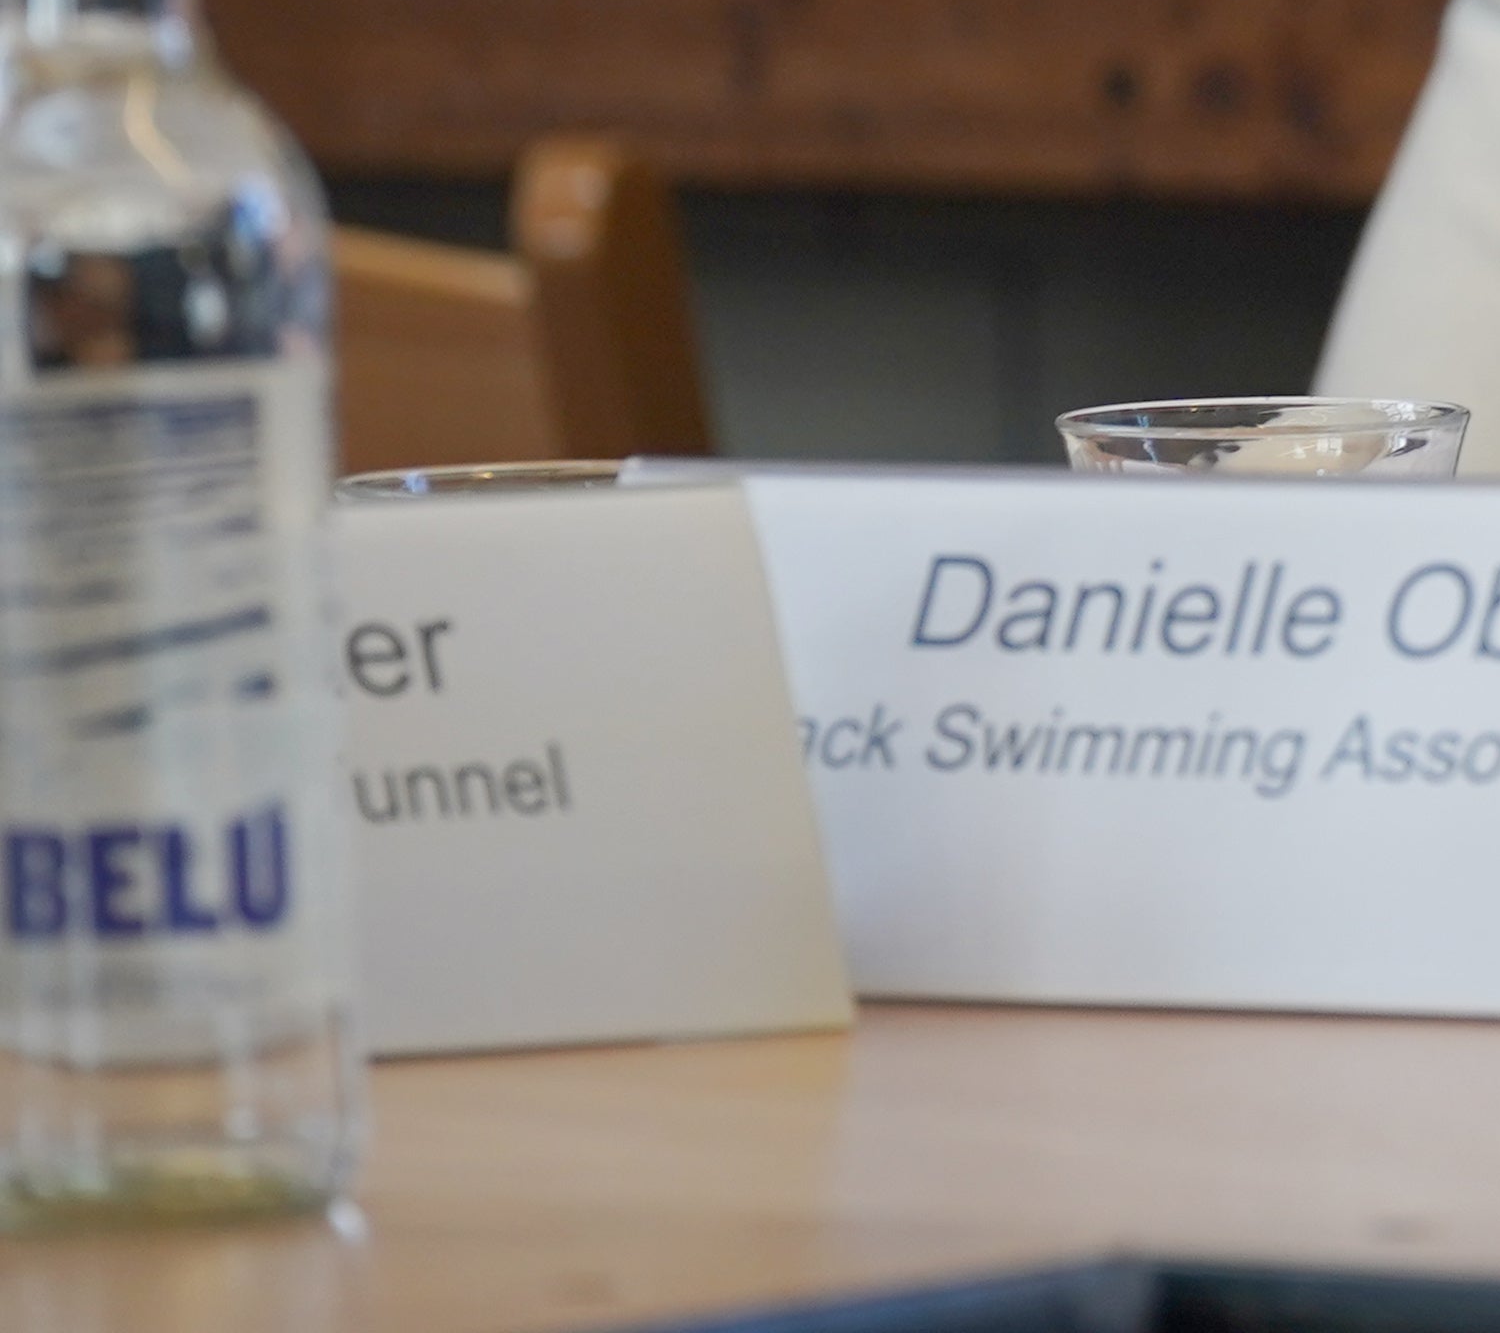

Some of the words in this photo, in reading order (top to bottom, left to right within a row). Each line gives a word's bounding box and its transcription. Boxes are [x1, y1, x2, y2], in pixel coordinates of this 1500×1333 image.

[908, 553, 1345, 659] Danielle
[351, 737, 571, 824] unnel
[797, 701, 903, 772] ack
[923, 702, 1312, 799] Swimming
[7, 799, 290, 935] BELU
